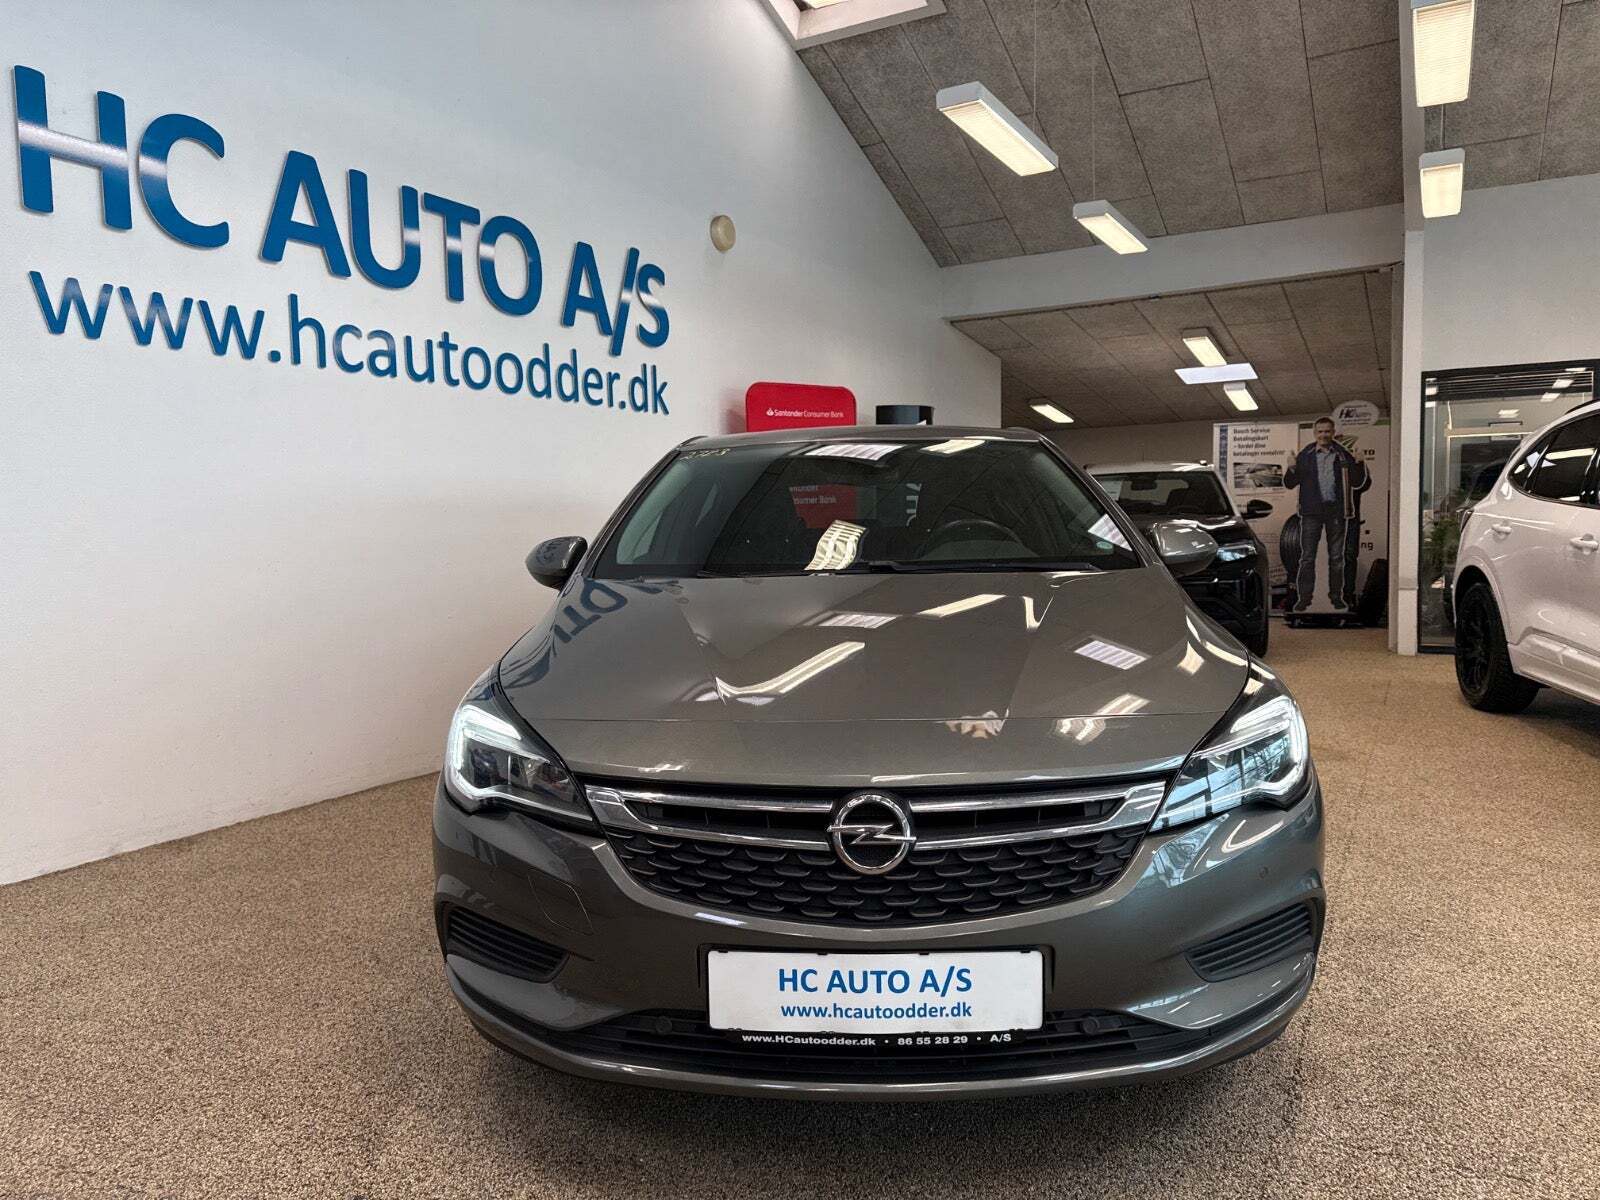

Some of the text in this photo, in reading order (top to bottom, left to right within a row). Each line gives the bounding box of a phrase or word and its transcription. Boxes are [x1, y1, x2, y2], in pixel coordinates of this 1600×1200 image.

[13, 64, 671, 357] HC AUTO A/S
[28, 270, 671, 416] www.hcautoodder.dk
[774, 409, 803, 417] Santander
[778, 965, 973, 997] HC AUTO A/S
[780, 1001, 972, 1020] www.hcautoodder.dk
[741, 1033, 1012, 1046] www.HCautoodder.dk 86 55 28 29 A/S
